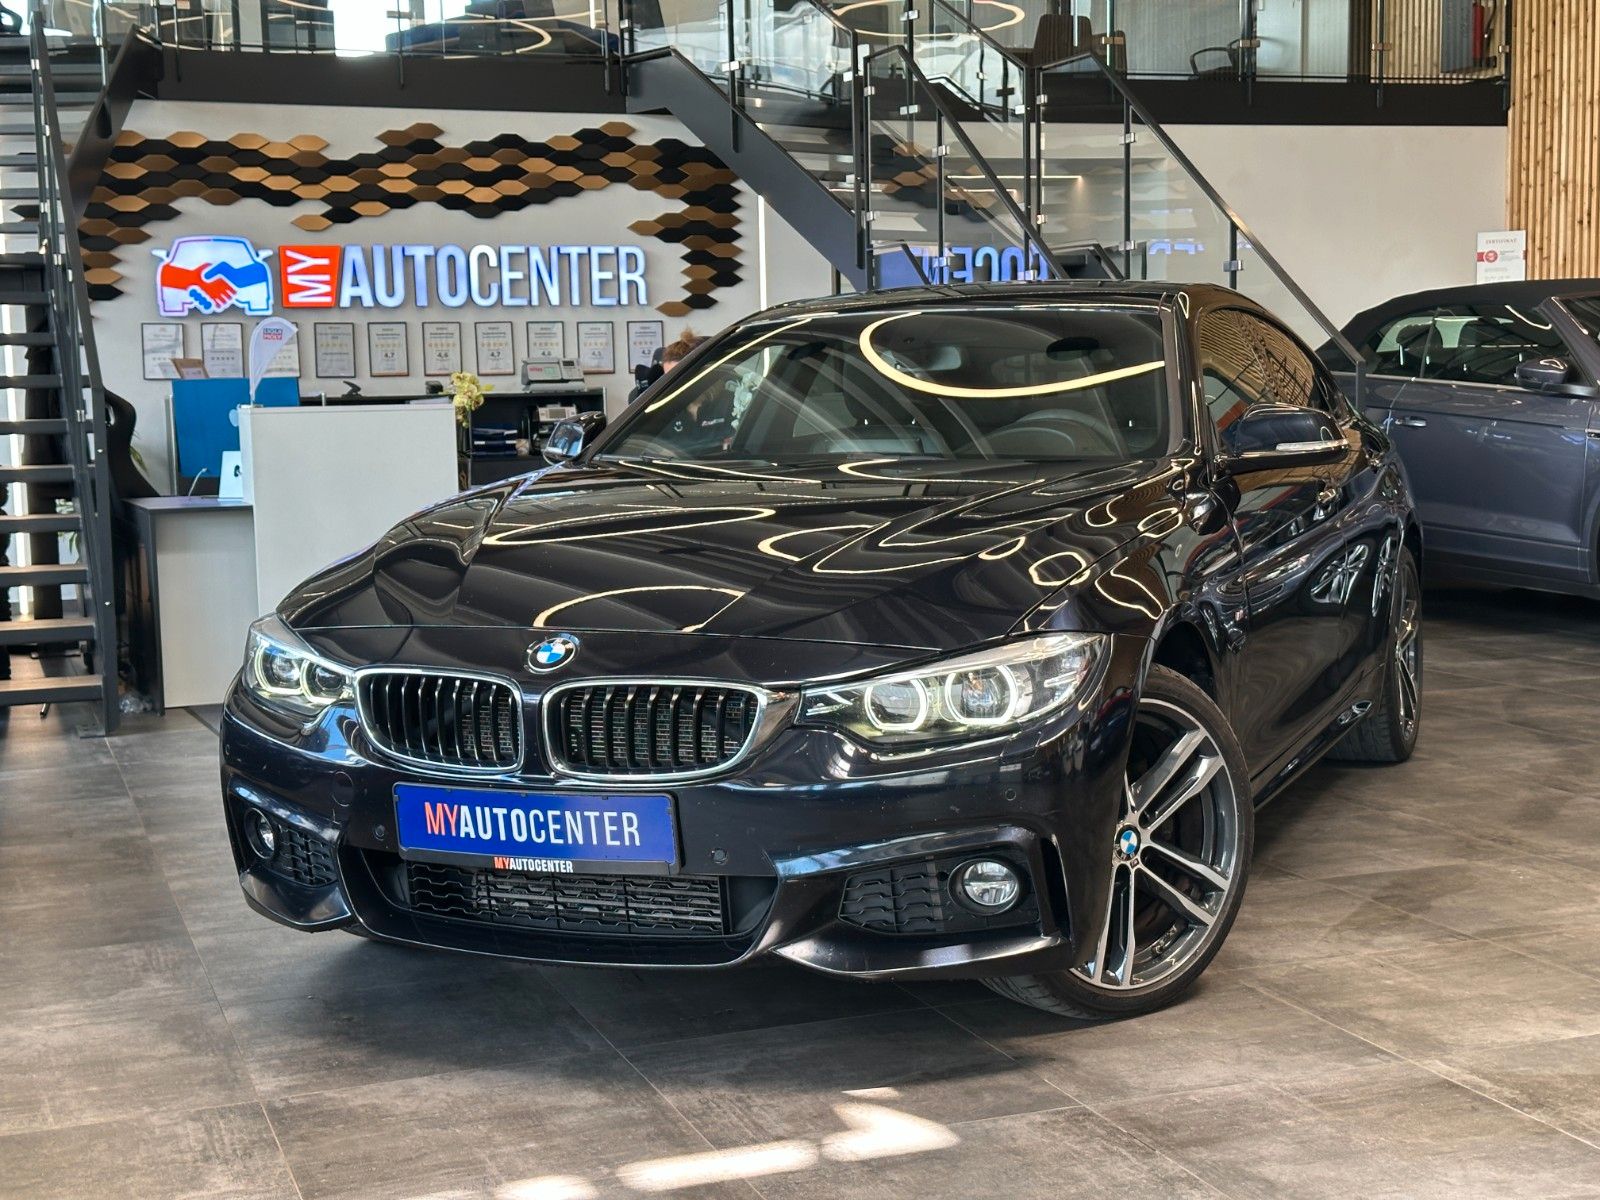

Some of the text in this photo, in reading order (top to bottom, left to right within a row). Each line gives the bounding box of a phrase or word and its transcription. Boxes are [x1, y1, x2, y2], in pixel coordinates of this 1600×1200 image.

[285, 244, 648, 307] MY AUTOCENTER
[424, 802, 641, 847] MYAUTOCENTER
[493, 857, 574, 873] MYAUTOCENTER
